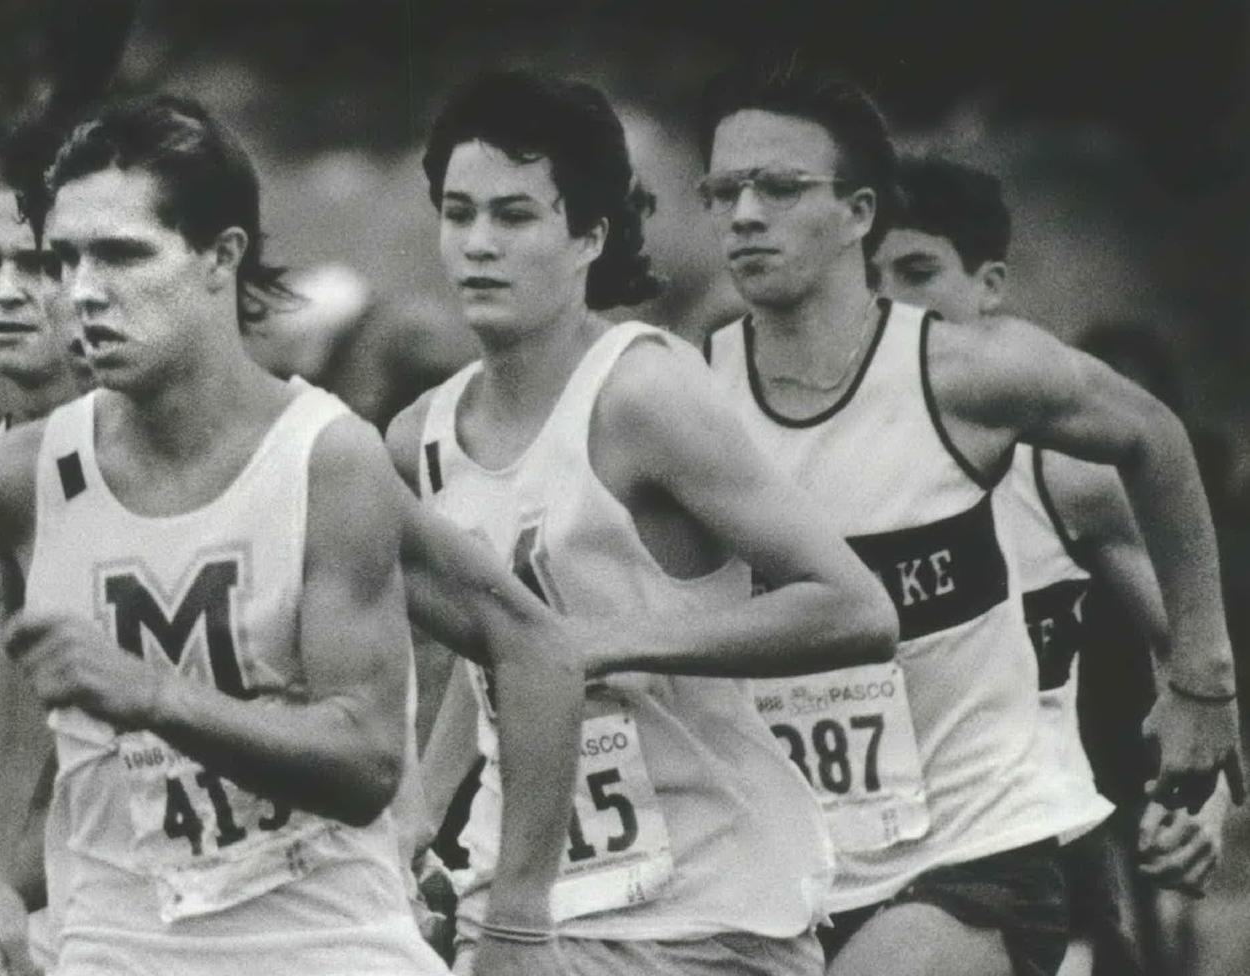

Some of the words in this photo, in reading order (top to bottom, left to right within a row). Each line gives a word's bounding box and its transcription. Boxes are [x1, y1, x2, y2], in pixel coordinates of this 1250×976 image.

[97, 550, 258, 700] M
[829, 680, 895, 703] PASCO
[581, 731, 628, 757] SCO
